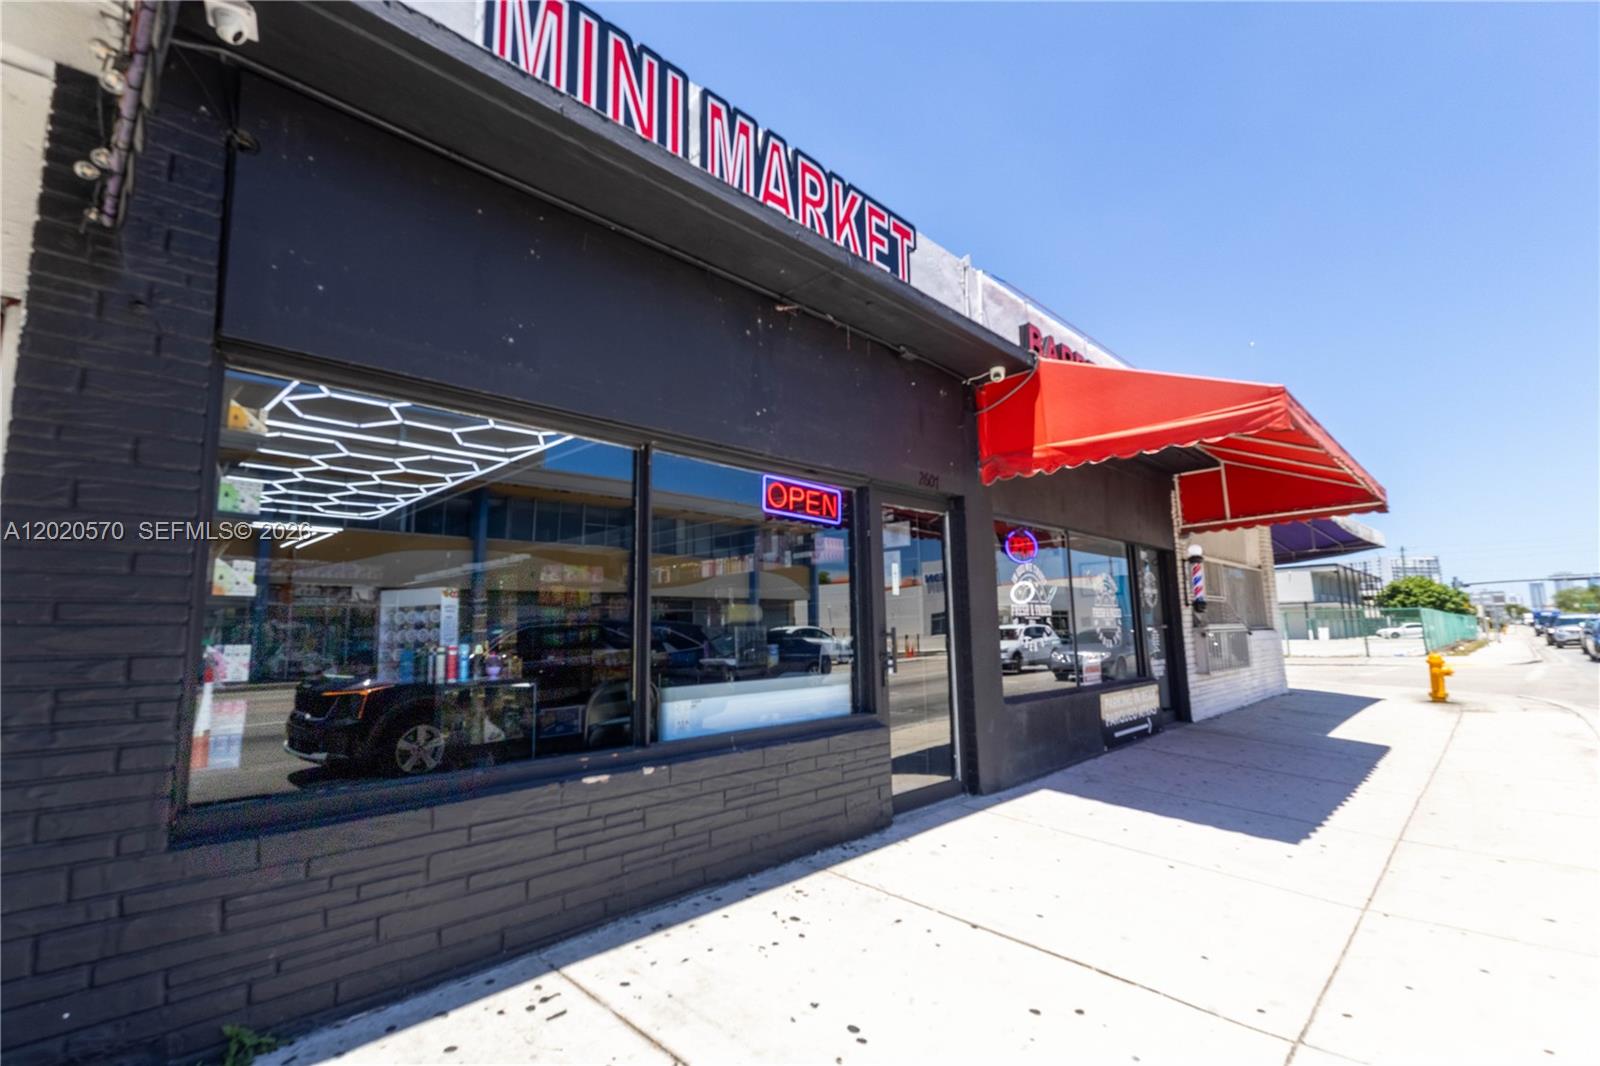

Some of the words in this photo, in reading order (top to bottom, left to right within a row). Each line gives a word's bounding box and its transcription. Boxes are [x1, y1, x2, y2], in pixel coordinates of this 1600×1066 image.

[485, 0, 689, 160] MINI
[704, 88, 916, 284] MARKET
[767, 482, 837, 518] OPEN
